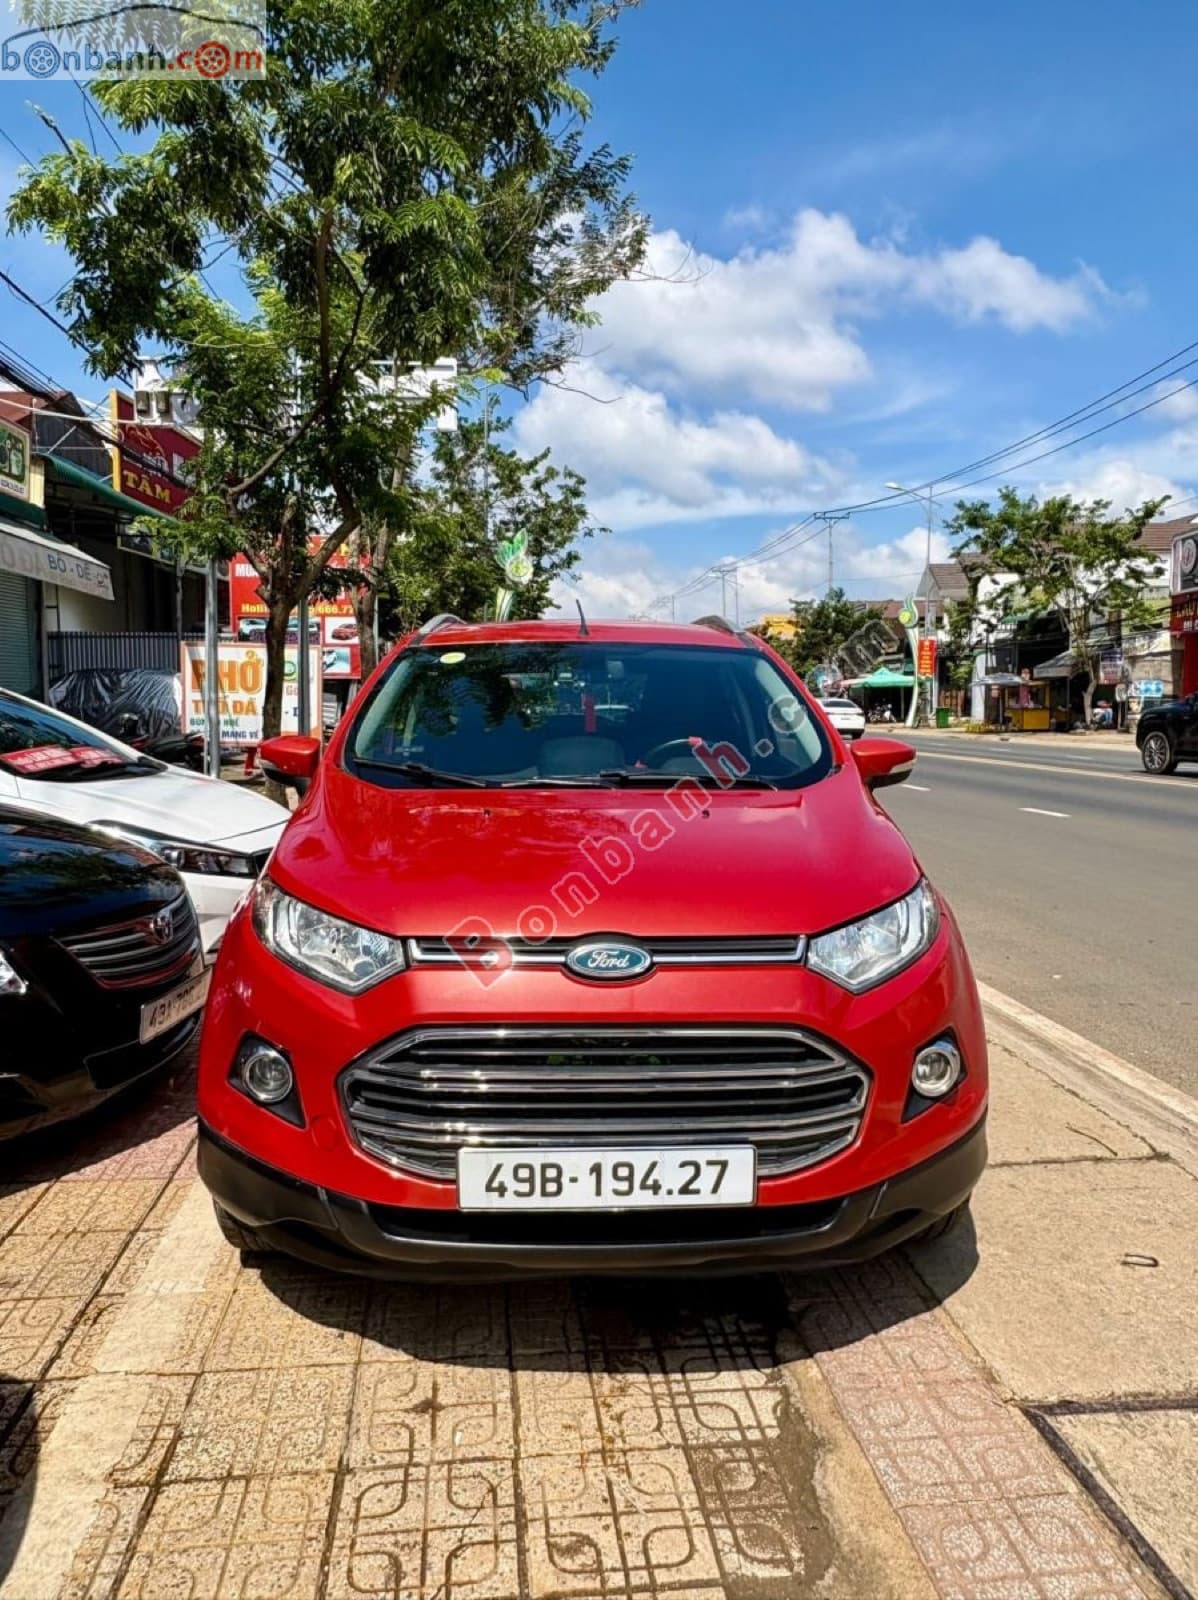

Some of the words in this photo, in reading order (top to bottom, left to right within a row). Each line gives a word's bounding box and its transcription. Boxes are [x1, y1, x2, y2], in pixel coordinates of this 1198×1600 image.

[191, 650, 264, 694] PHỞ
[587, 951, 630, 967] Ford
[485, 1160, 729, 1198] 49B-194.27
